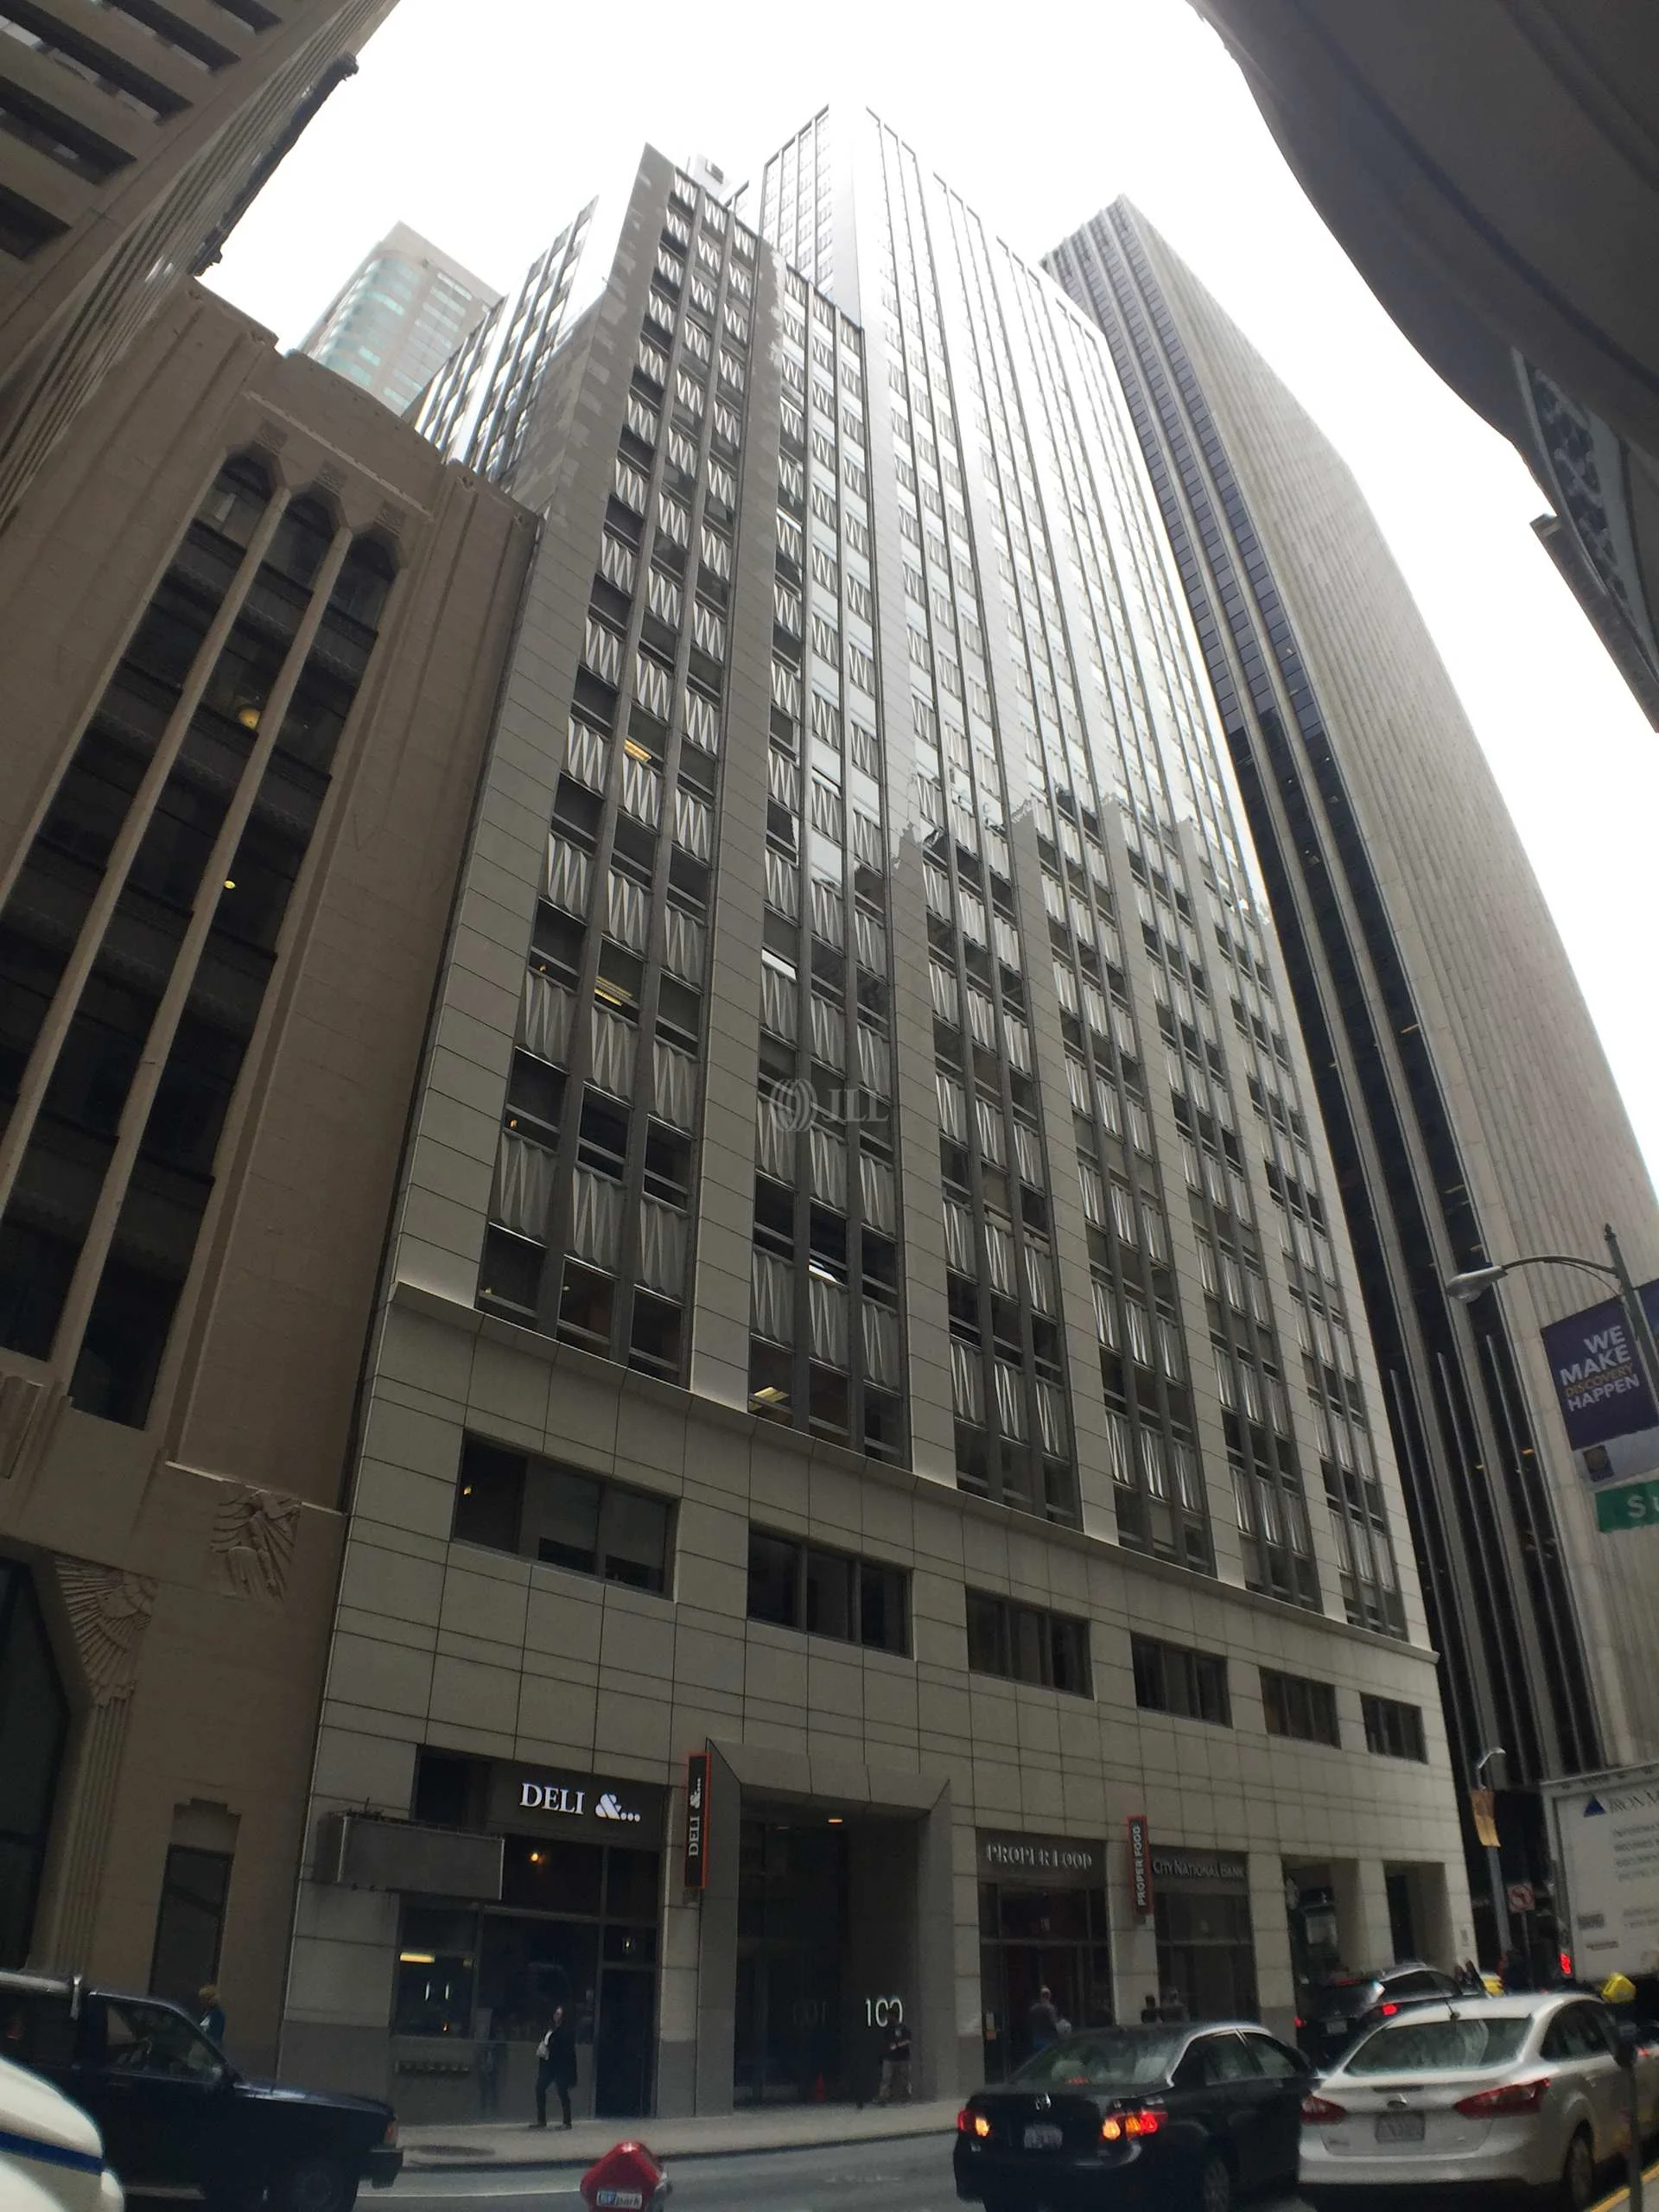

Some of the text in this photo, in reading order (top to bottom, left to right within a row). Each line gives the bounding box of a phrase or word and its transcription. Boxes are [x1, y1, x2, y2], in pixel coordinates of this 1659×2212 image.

[1584, 1325, 1625, 1355] WE
[1560, 1344, 1630, 1386] MAKE
[1565, 1363, 1633, 1397] DISCOVERY
[1567, 1373, 1639, 1412] HAPPEN
[519, 1783, 586, 1815] DELI
[689, 1815, 700, 1857] DELI
[1132, 1825, 1146, 1906] PROPER FOOD
